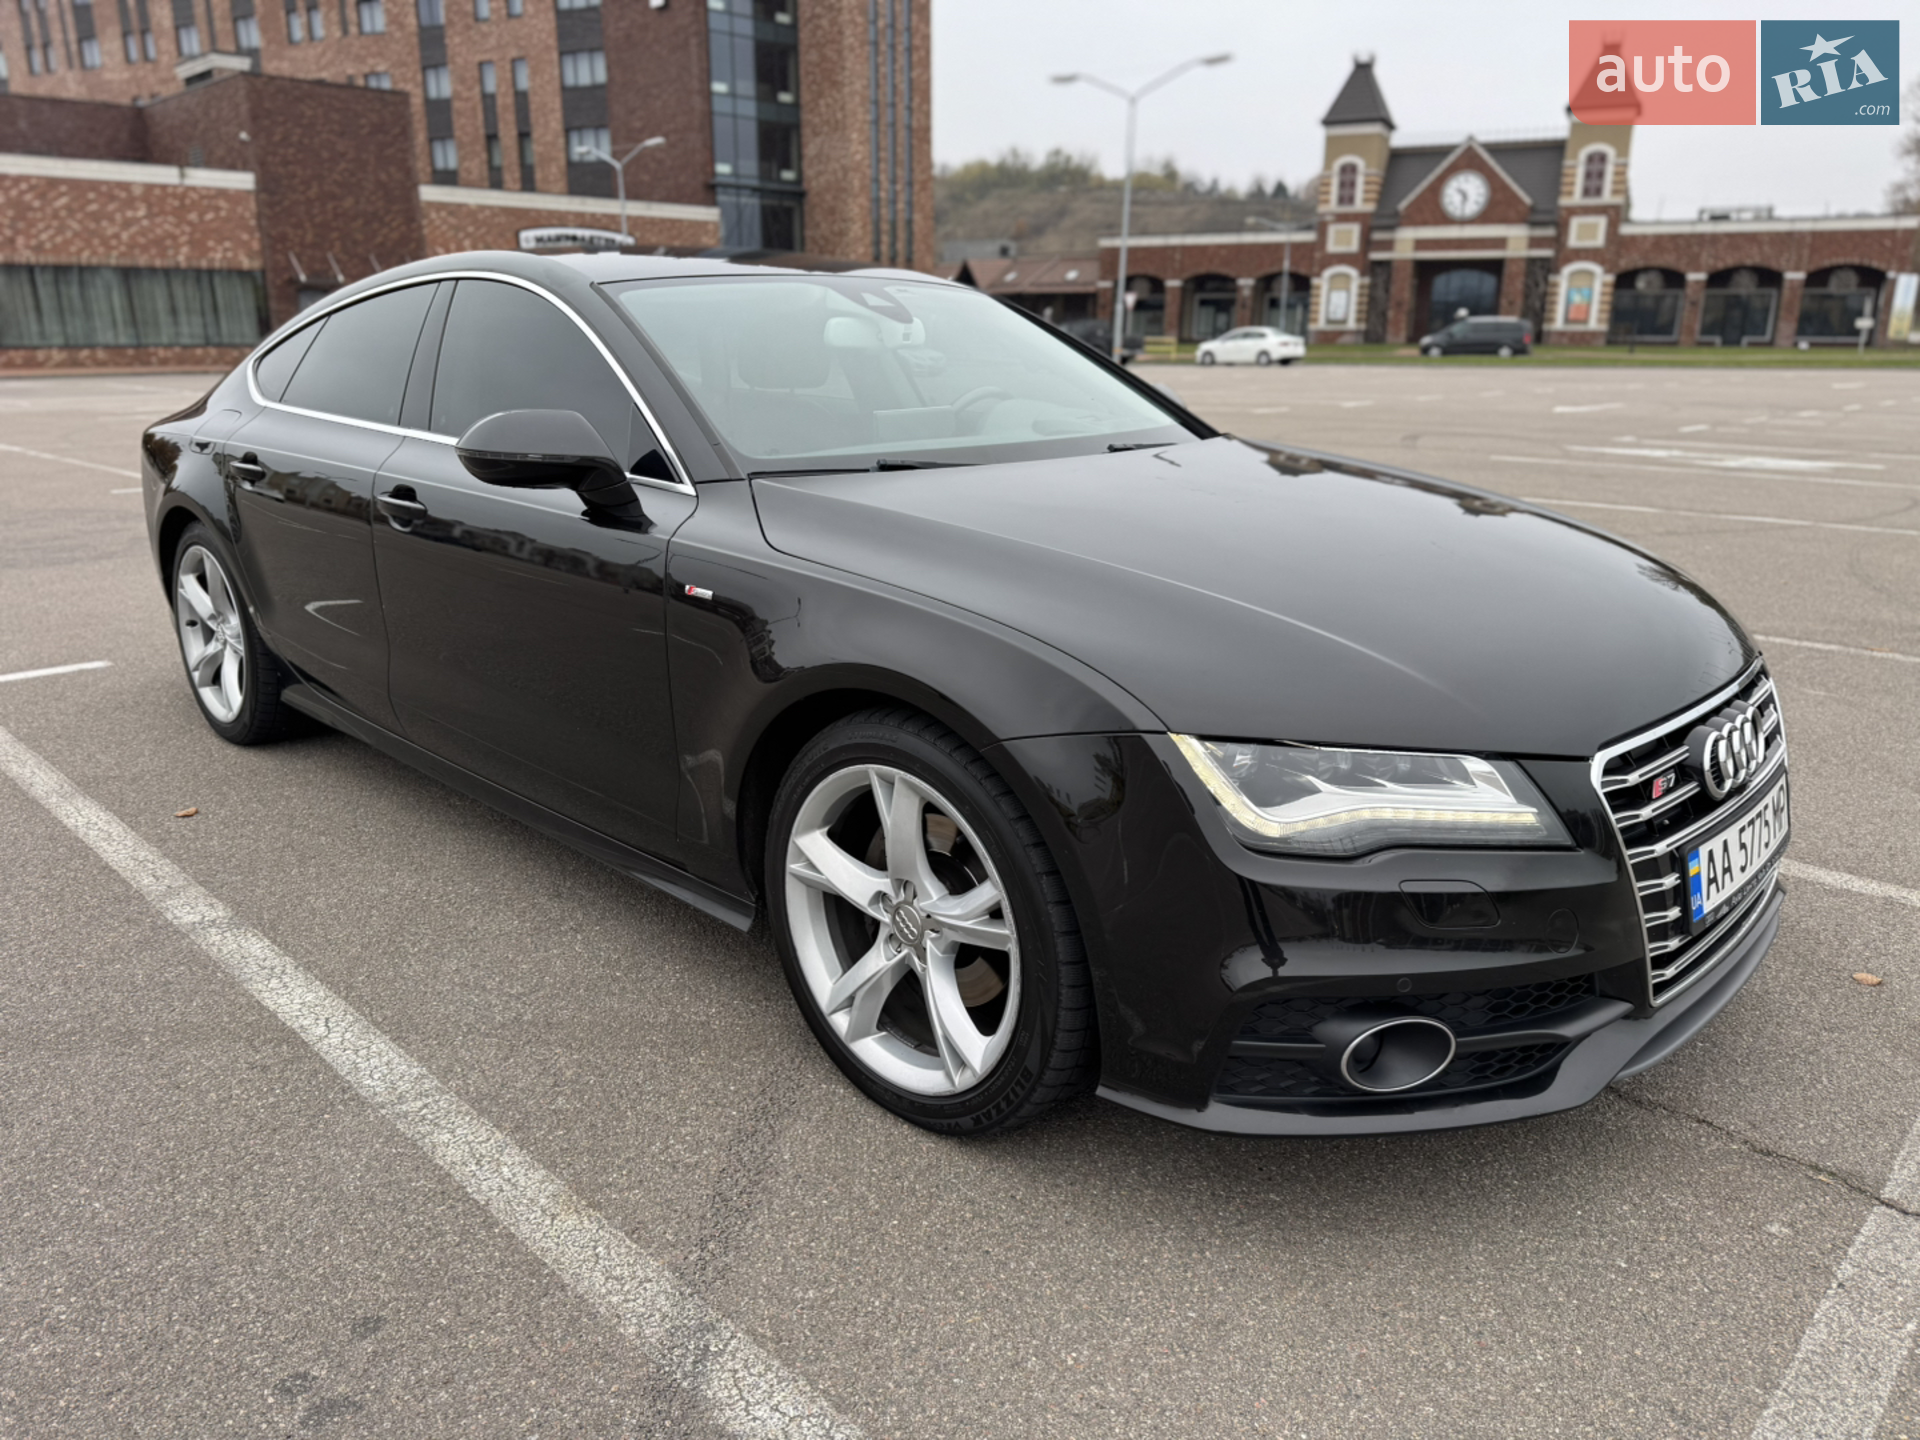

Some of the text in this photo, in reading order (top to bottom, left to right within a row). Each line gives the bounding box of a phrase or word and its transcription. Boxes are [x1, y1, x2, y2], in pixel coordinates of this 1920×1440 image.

[1706, 838, 1734, 901] AA
[1738, 803, 1771, 874] 5775
[1691, 892, 1704, 911] UA
[969, 1064, 1035, 1128] BLIZZAK
